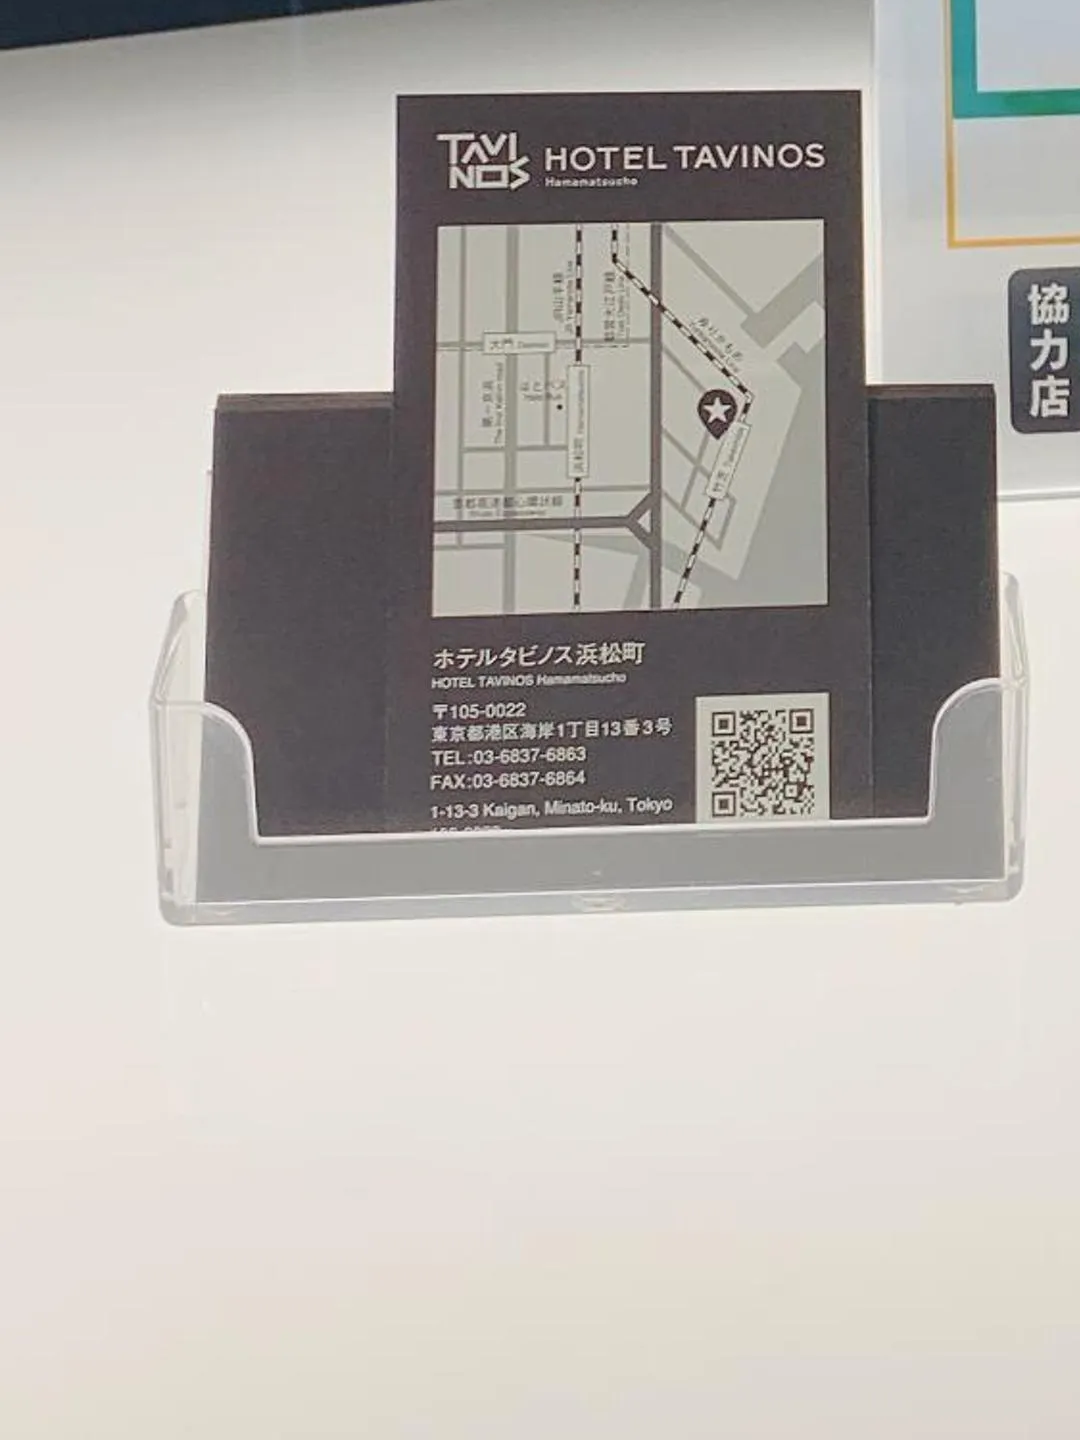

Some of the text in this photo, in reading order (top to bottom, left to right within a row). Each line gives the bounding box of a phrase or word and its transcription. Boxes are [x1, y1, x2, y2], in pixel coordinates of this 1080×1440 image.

[544, 142, 826, 172] HOTEL TAVINOS
[1028, 282, 1072, 419] 協力店
[433, 641, 645, 670] ホテルタビノス浜松町
[431, 672, 627, 688] HOTEL TAVINOS Hamamatsucho
[431, 803, 479, 819] 1-13-3
[483, 800, 541, 821] Kaigan,
[626, 795, 674, 814] Tokyo
